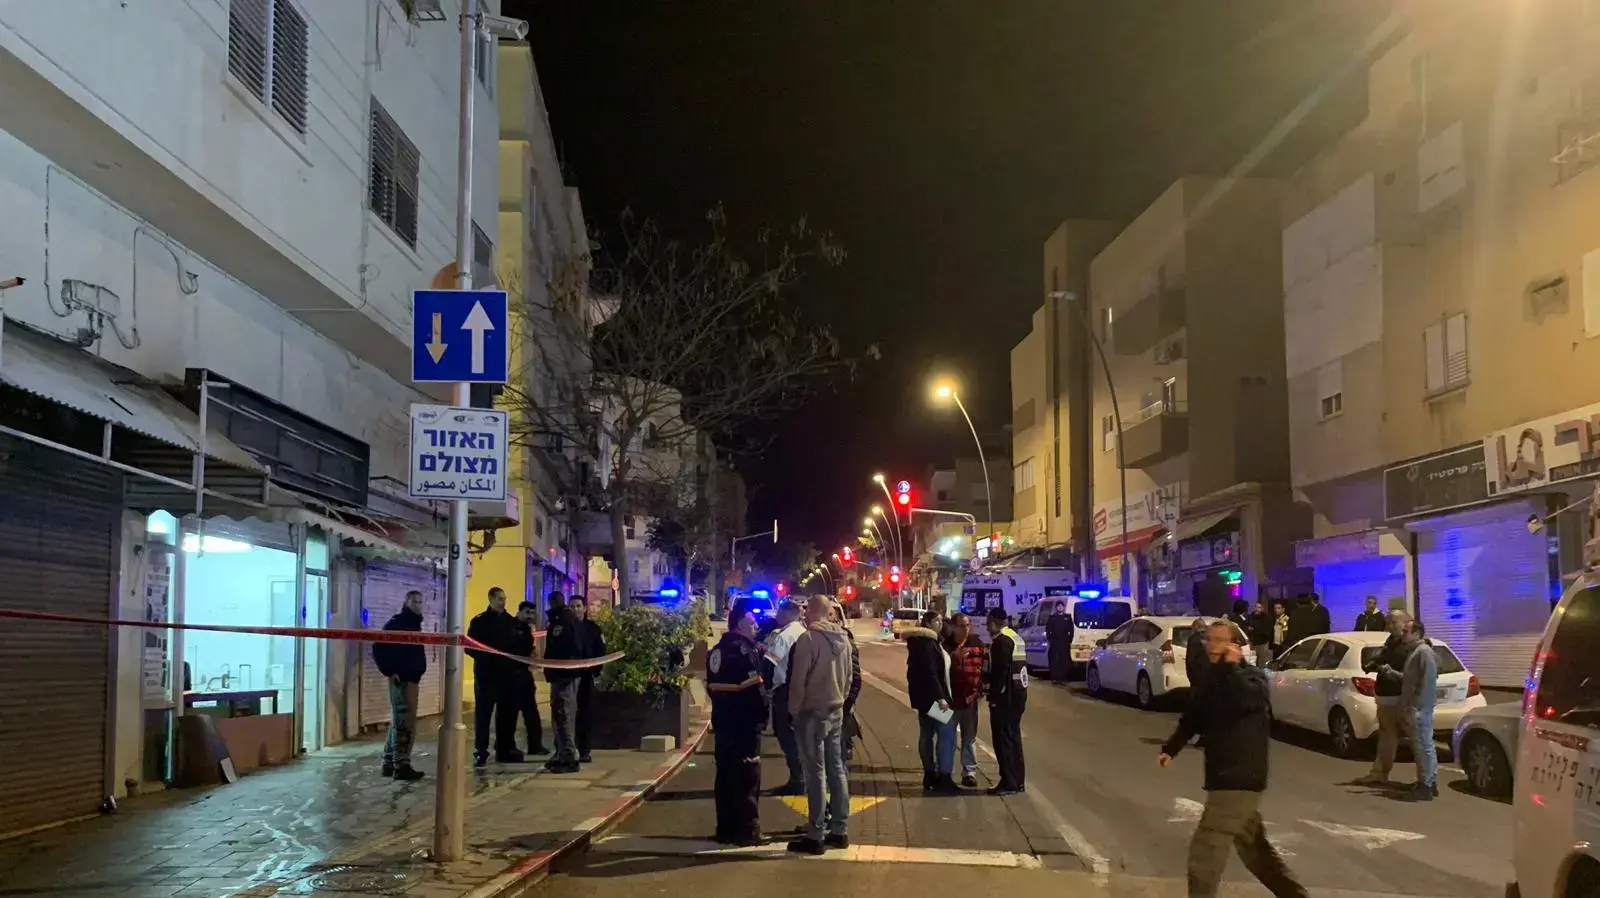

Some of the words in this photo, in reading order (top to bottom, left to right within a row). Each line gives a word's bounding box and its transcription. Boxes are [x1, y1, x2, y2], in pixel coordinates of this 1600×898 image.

[423, 429, 495, 450] האזור
[419, 451, 498, 475] מצולם
[417, 481, 456, 493] مصور
[459, 478, 496, 494] المكان
[451, 543, 461, 560] 9
